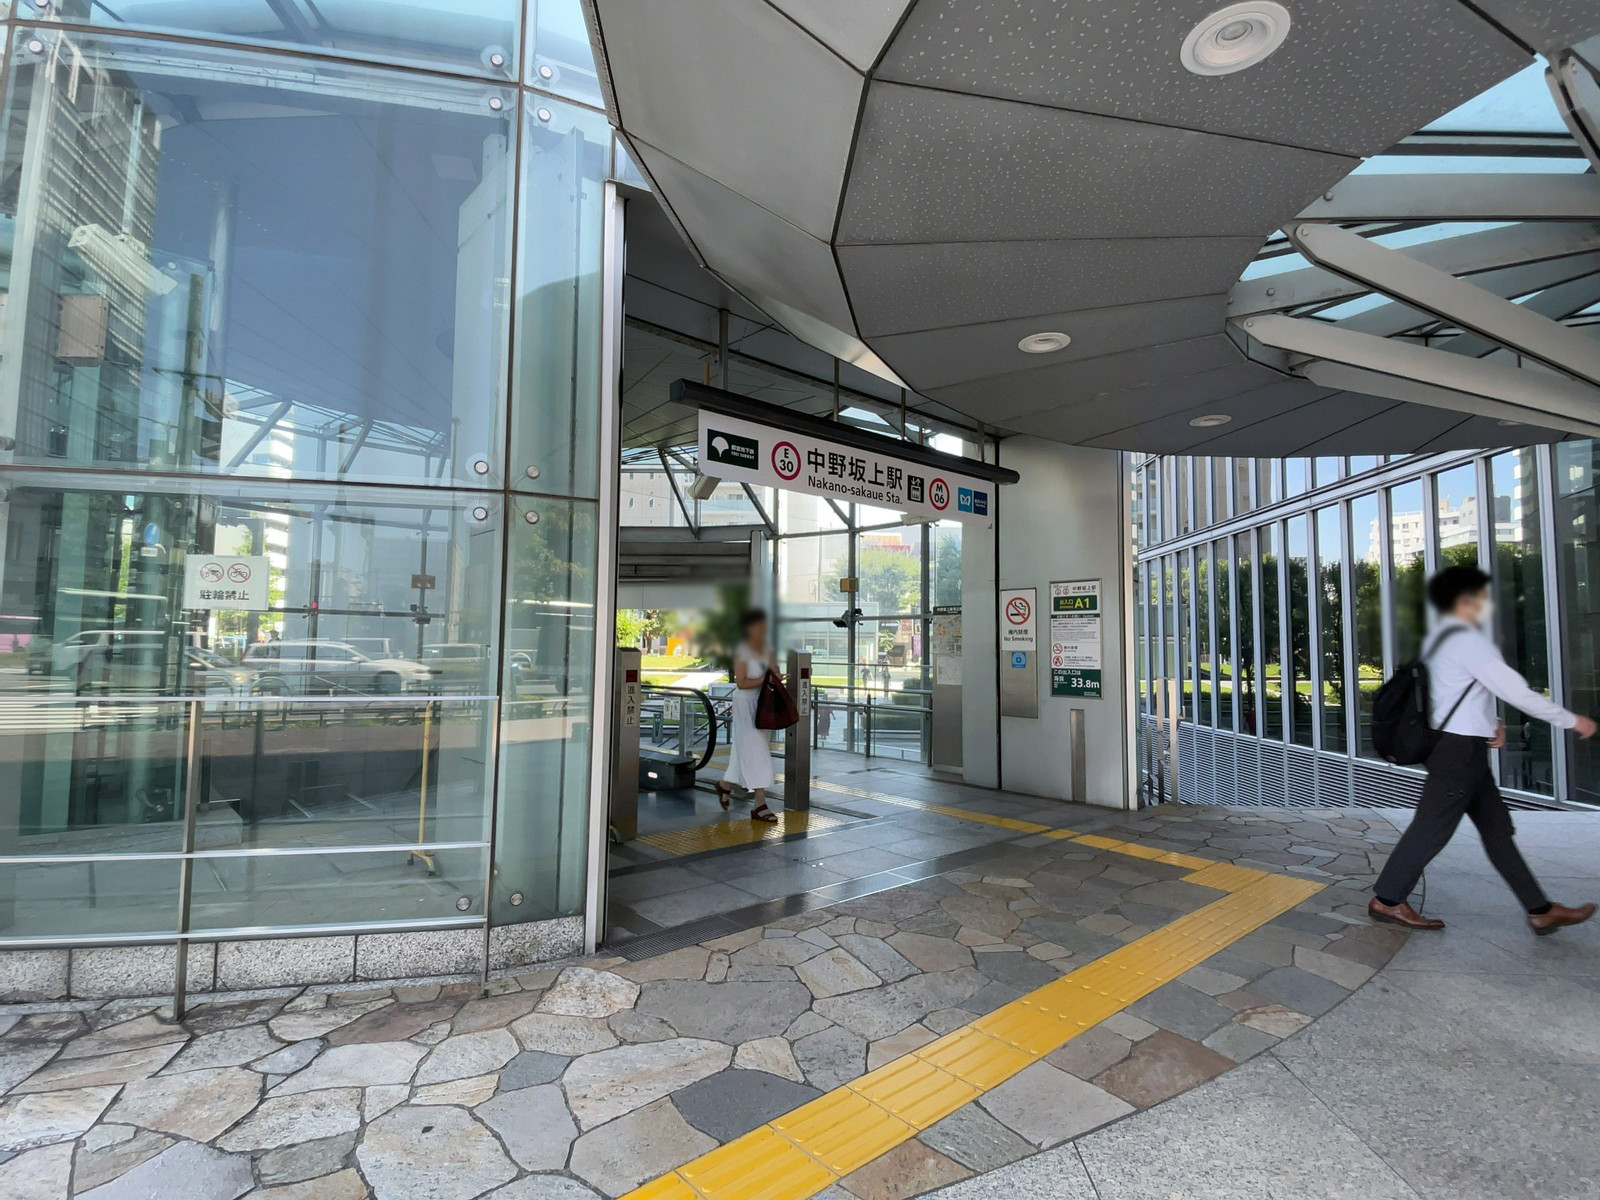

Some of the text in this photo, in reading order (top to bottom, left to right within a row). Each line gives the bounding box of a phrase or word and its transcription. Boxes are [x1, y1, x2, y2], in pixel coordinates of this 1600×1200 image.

[784, 448, 789, 459] E
[780, 459, 794, 473] 30
[807, 448, 903, 490] 中野坂上駅
[808, 475, 903, 505] Nakano-sakaue Sta.
[936, 483, 943, 493] M
[934, 493, 945, 504] 06
[199, 589, 249, 600] 駐輪禁止
[1074, 597, 1089, 609] A1
[1071, 677, 1100, 688] 33.8m
[626, 685, 635, 725] 進入禁止
